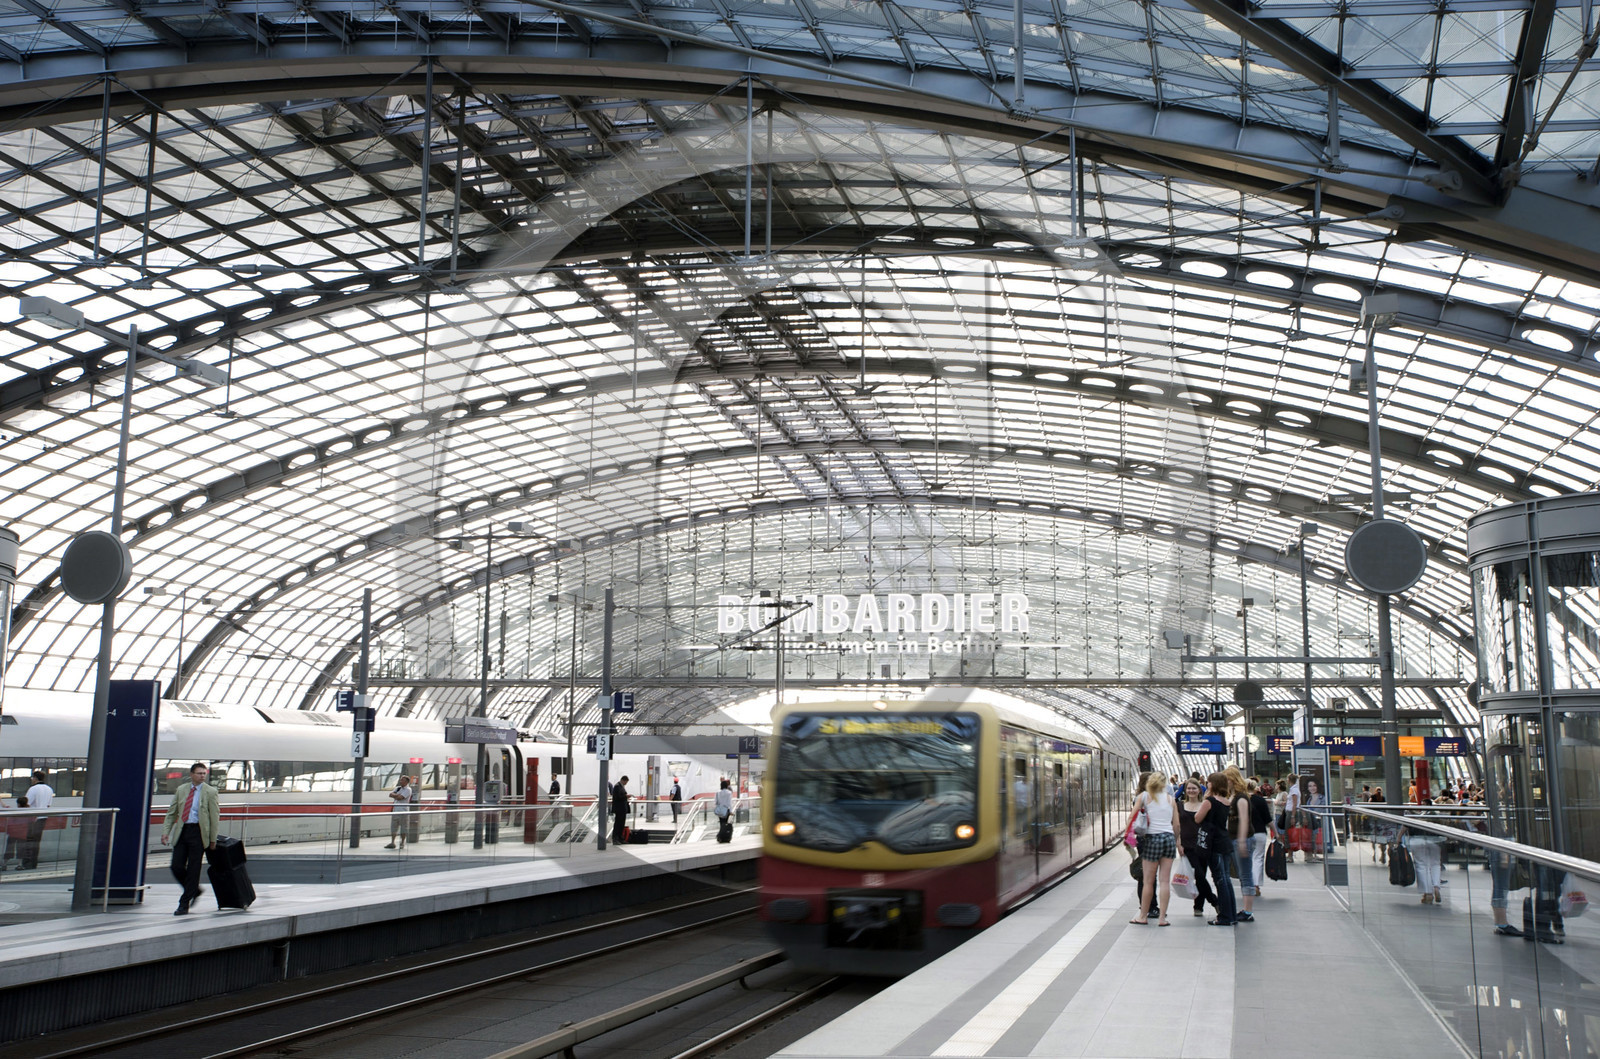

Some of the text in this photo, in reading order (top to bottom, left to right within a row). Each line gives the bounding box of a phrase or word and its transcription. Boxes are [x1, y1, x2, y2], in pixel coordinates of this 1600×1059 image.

[717, 593, 1031, 634] BOMBARDIER
[896, 634, 919, 653] in
[927, 634, 996, 654] Berlin
[337, 691, 348, 708] E
[621, 693, 632, 709] E
[1192, 708, 1206, 720] 15
[1212, 704, 1223, 718] H
[354, 733, 361, 743] 5
[599, 736, 606, 746] 5
[743, 738, 756, 750] 14
[1333, 736, 1355, 745] 11-14
[354, 744, 361, 755] 4
[599, 747, 606, 758] 4
